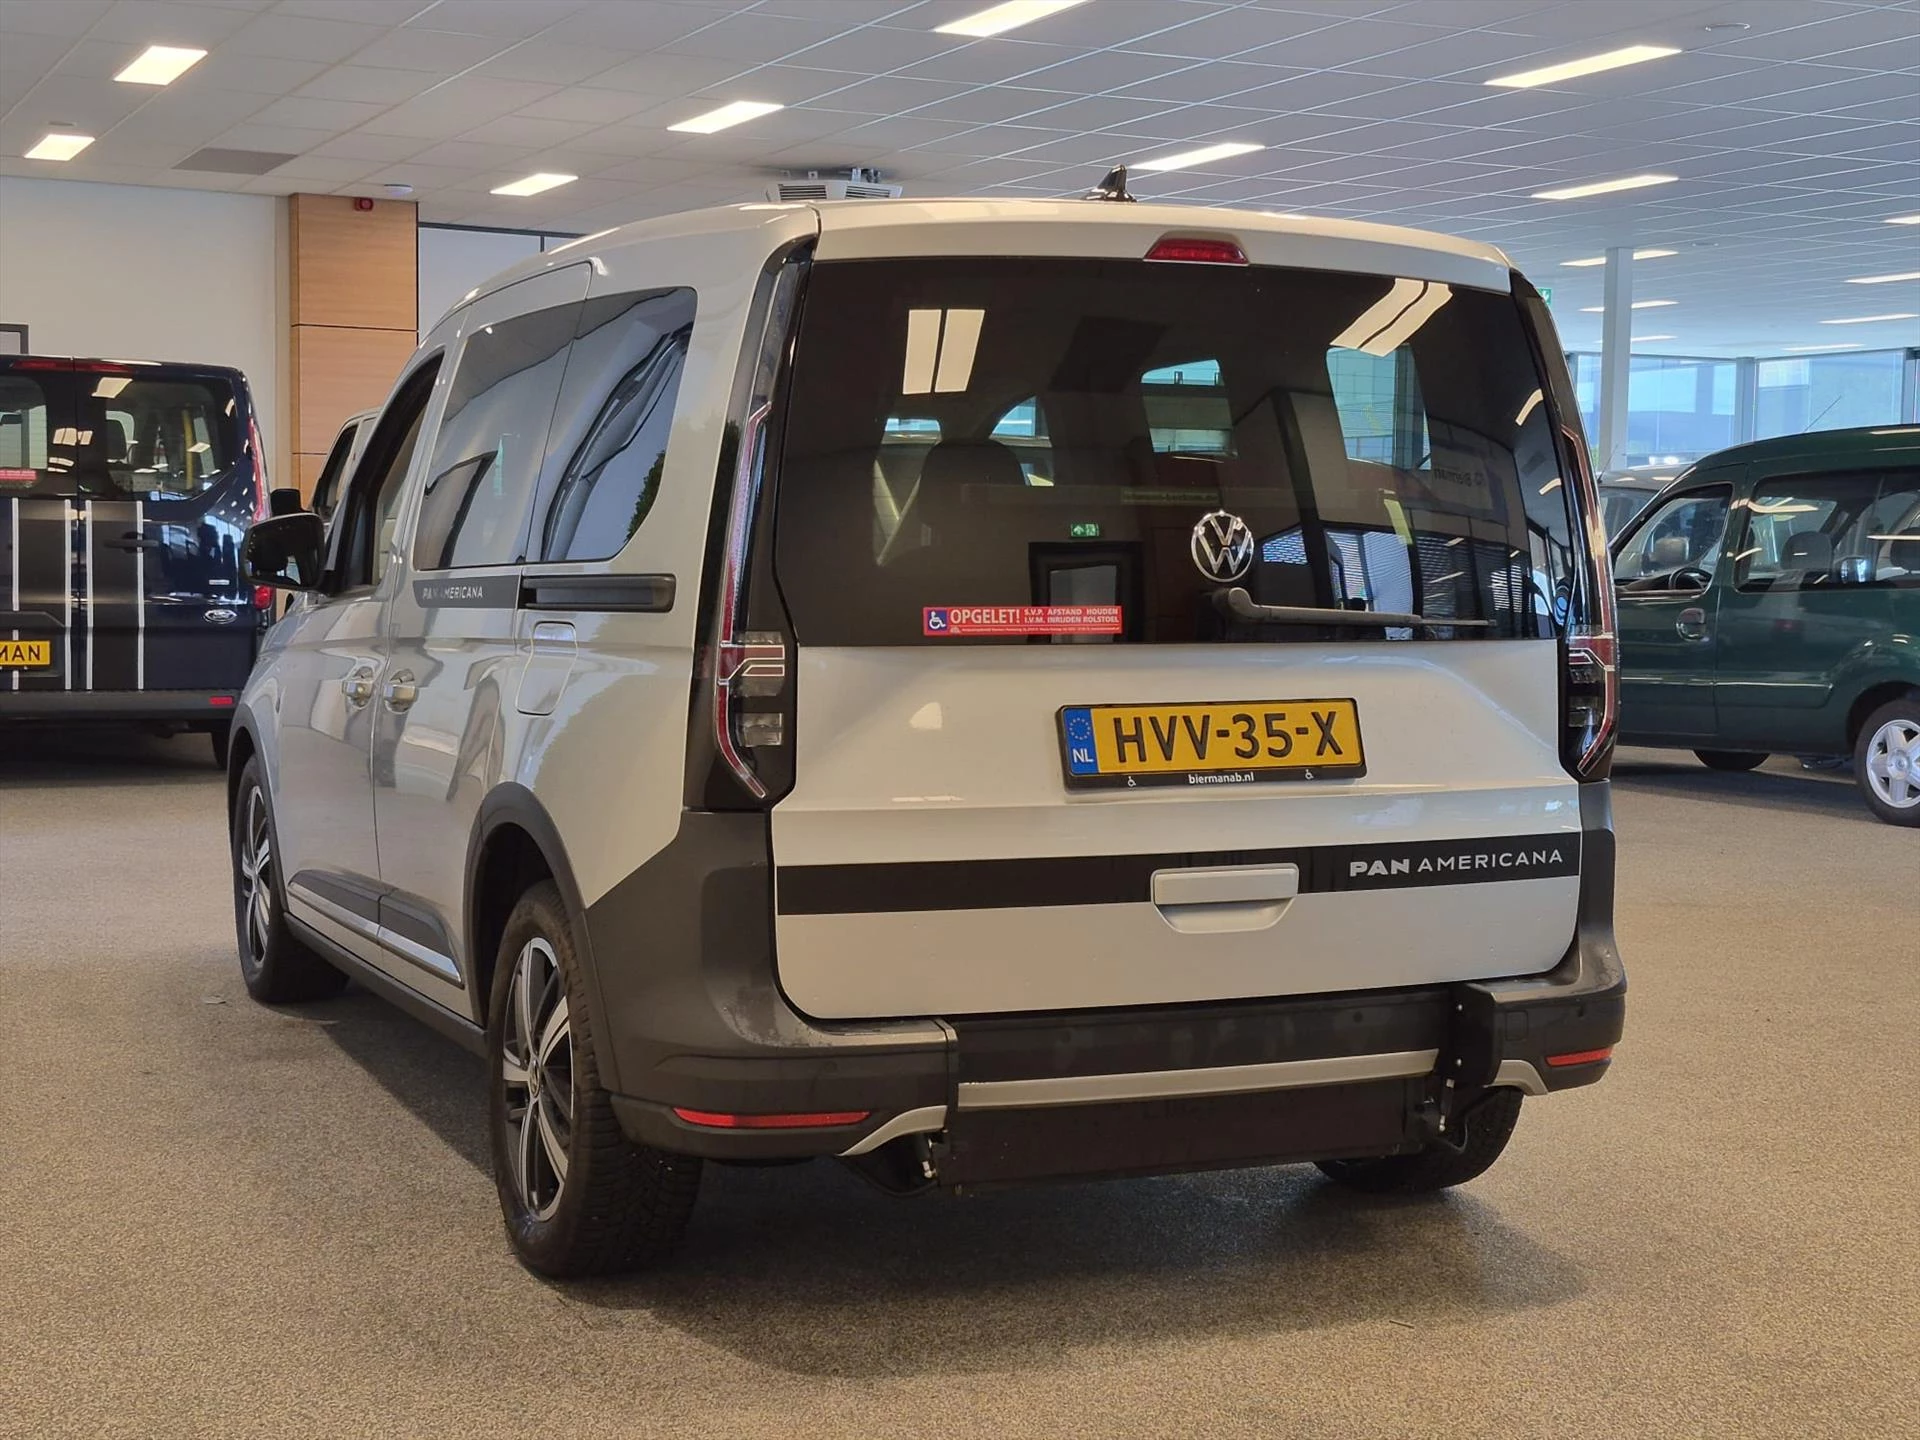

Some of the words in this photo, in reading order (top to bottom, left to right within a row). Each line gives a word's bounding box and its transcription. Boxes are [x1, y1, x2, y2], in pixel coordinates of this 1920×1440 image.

[440, 586, 483, 599] MERICANA
[950, 609, 1020, 625] OPGELET!
[1047, 608, 1082, 616] AFSTAND
[1086, 607, 1118, 615] HOUDEN
[1083, 615, 1119, 623] ROLSTOEL
[1113, 711, 1343, 763] HVV-35-X
[1072, 748, 1094, 763] NL
[1188, 771, 1254, 784] biermanab.nl
[1350, 858, 1410, 877] PAN
[1417, 849, 1563, 873] AMERICANA
